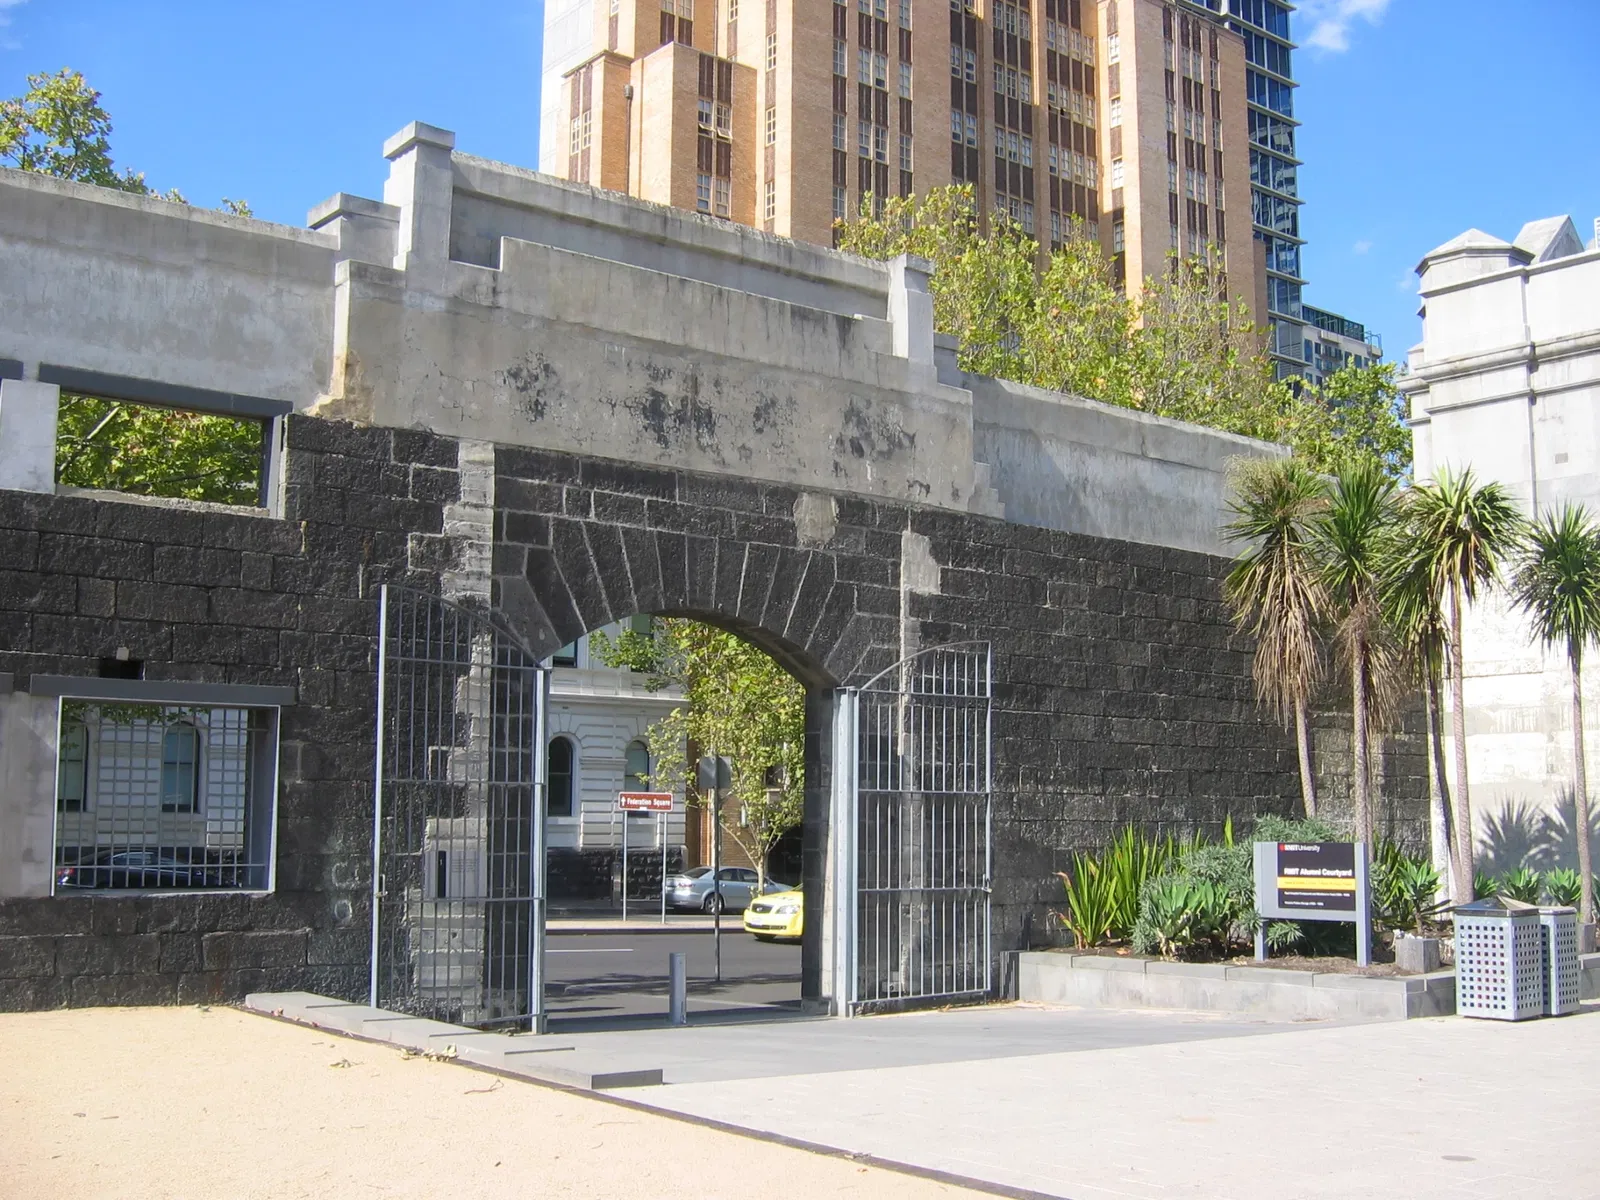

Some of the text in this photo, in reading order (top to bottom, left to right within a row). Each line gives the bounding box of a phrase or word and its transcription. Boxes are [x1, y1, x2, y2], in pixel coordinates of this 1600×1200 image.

[627, 797, 671, 807] Federation Square
[1298, 844, 1321, 852] University
[1284, 867, 1352, 877] RMIT Alumni Courtyard
